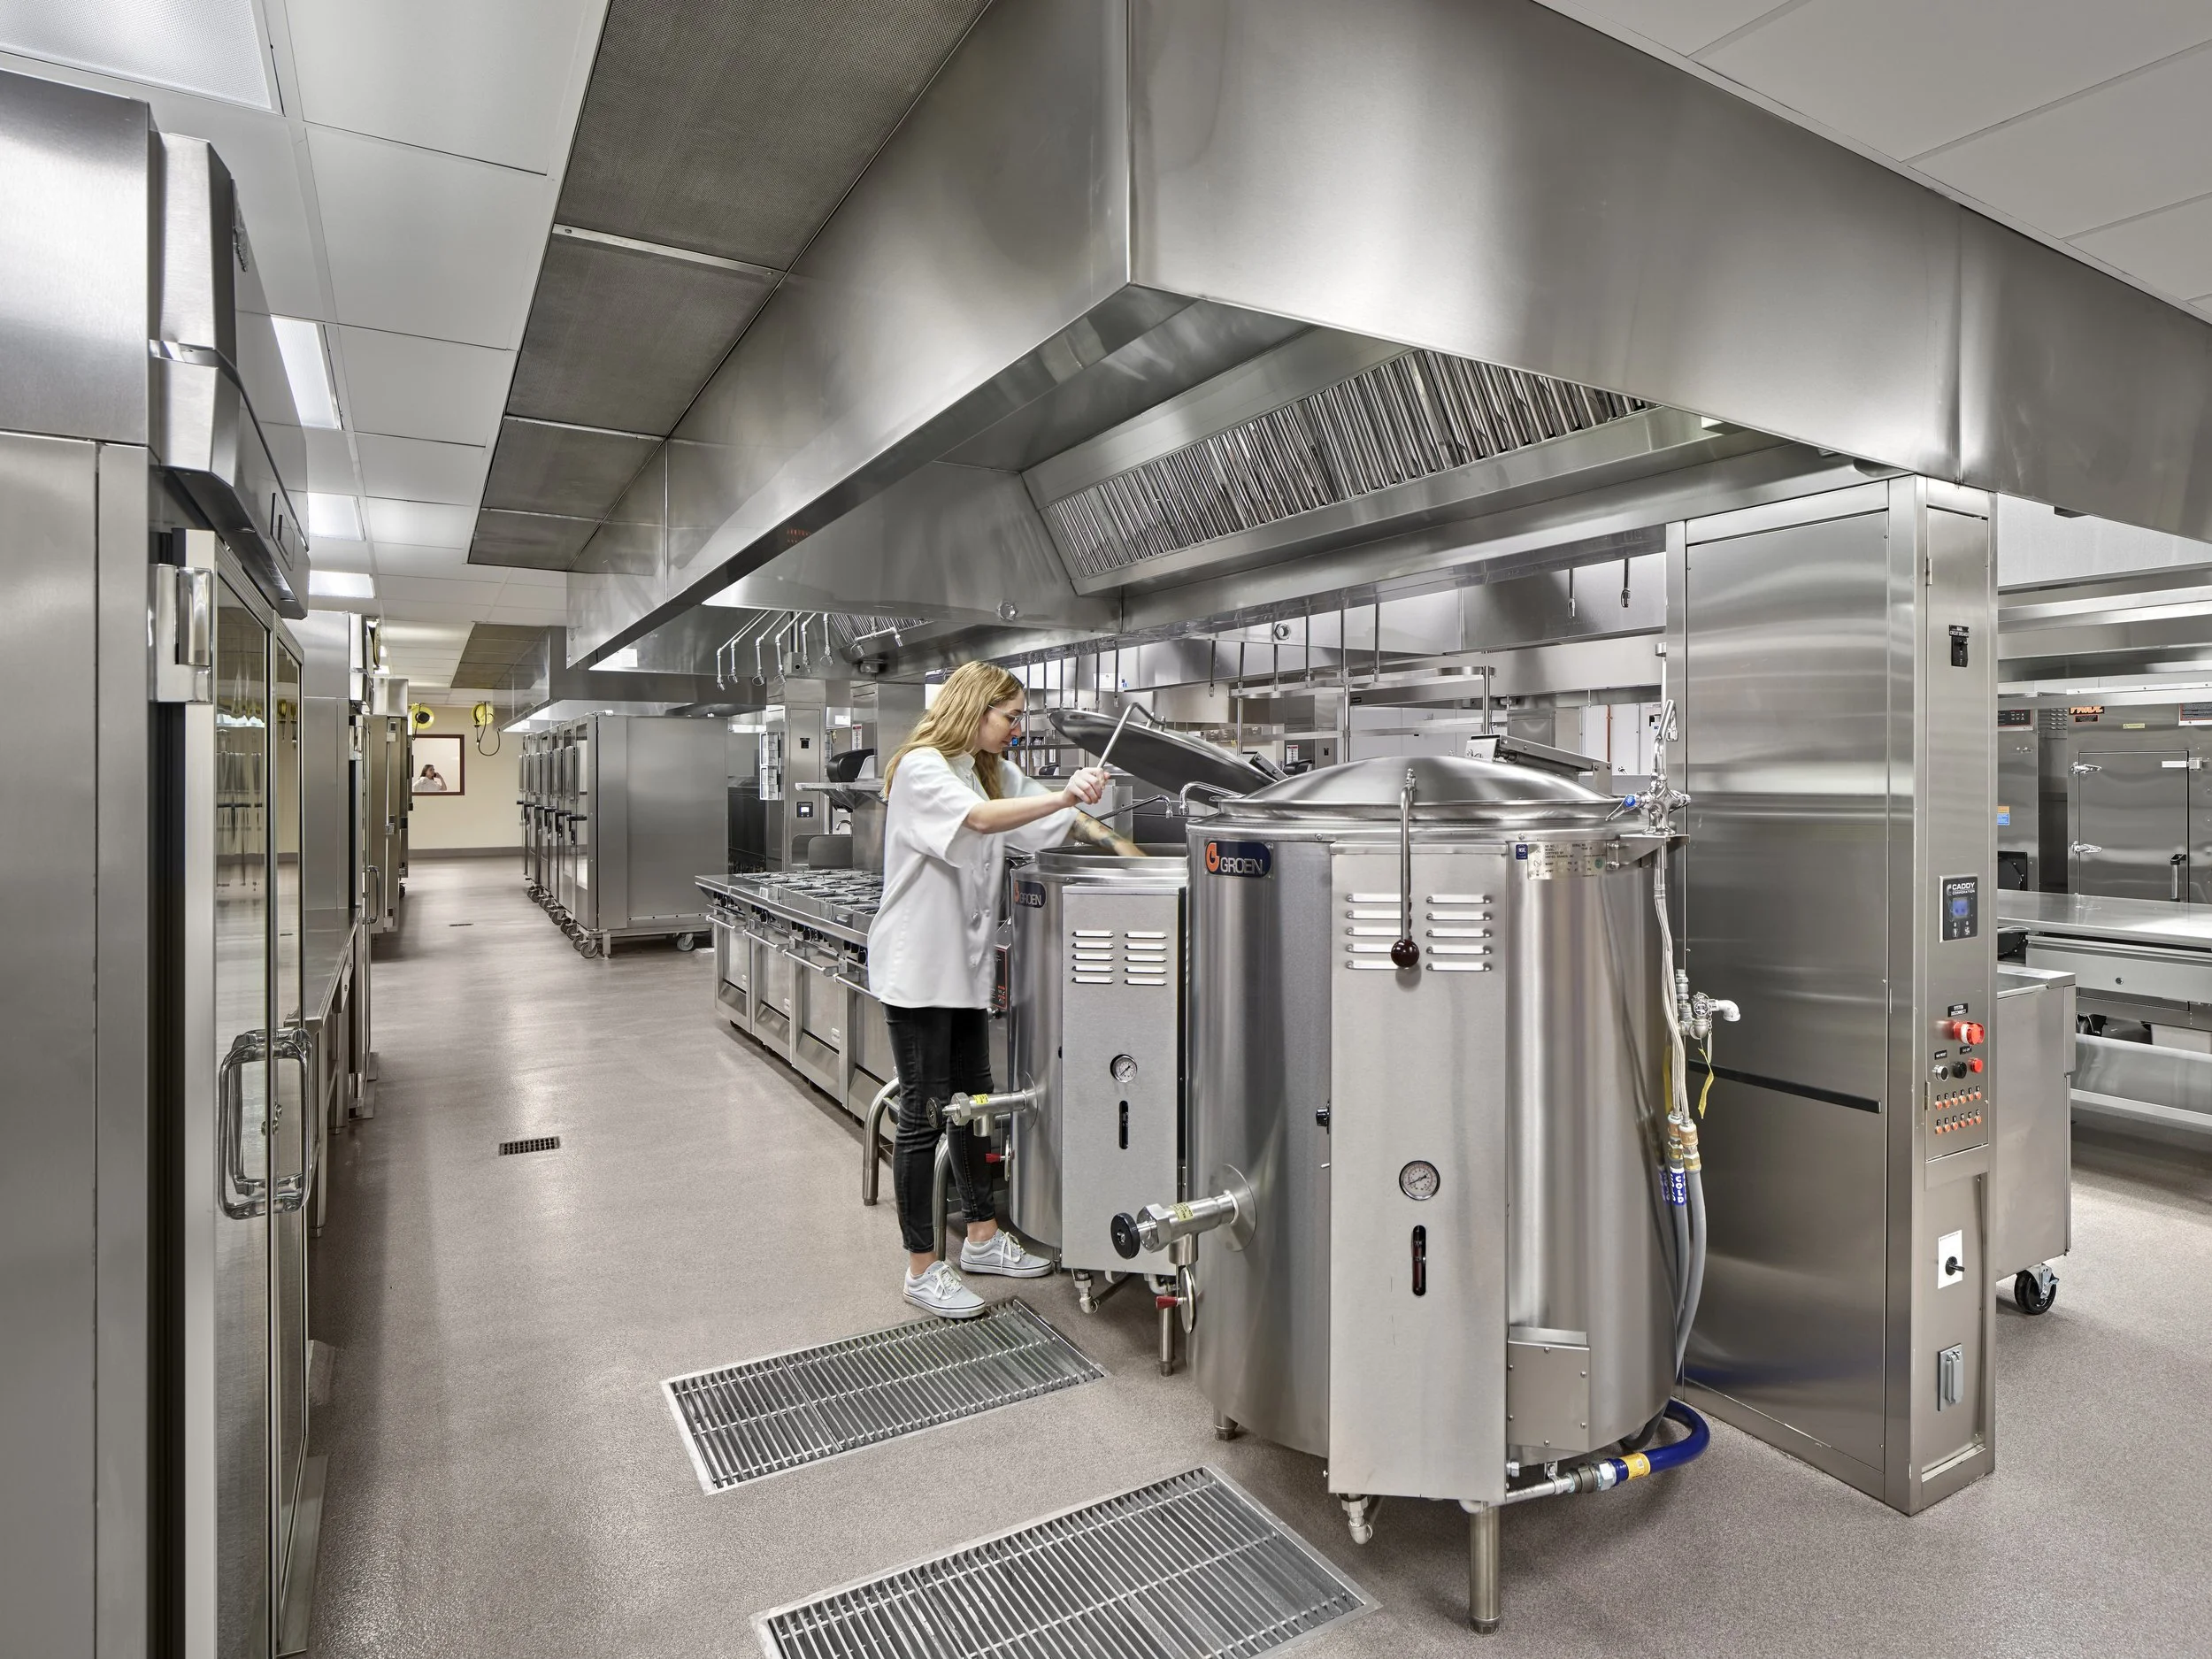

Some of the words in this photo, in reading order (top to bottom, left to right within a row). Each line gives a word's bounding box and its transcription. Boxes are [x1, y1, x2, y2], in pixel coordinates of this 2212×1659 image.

[1220, 856, 1263, 874] GROEN
[1019, 892, 1041, 906] GROEN
[1675, 1175, 1684, 1203] COLD
